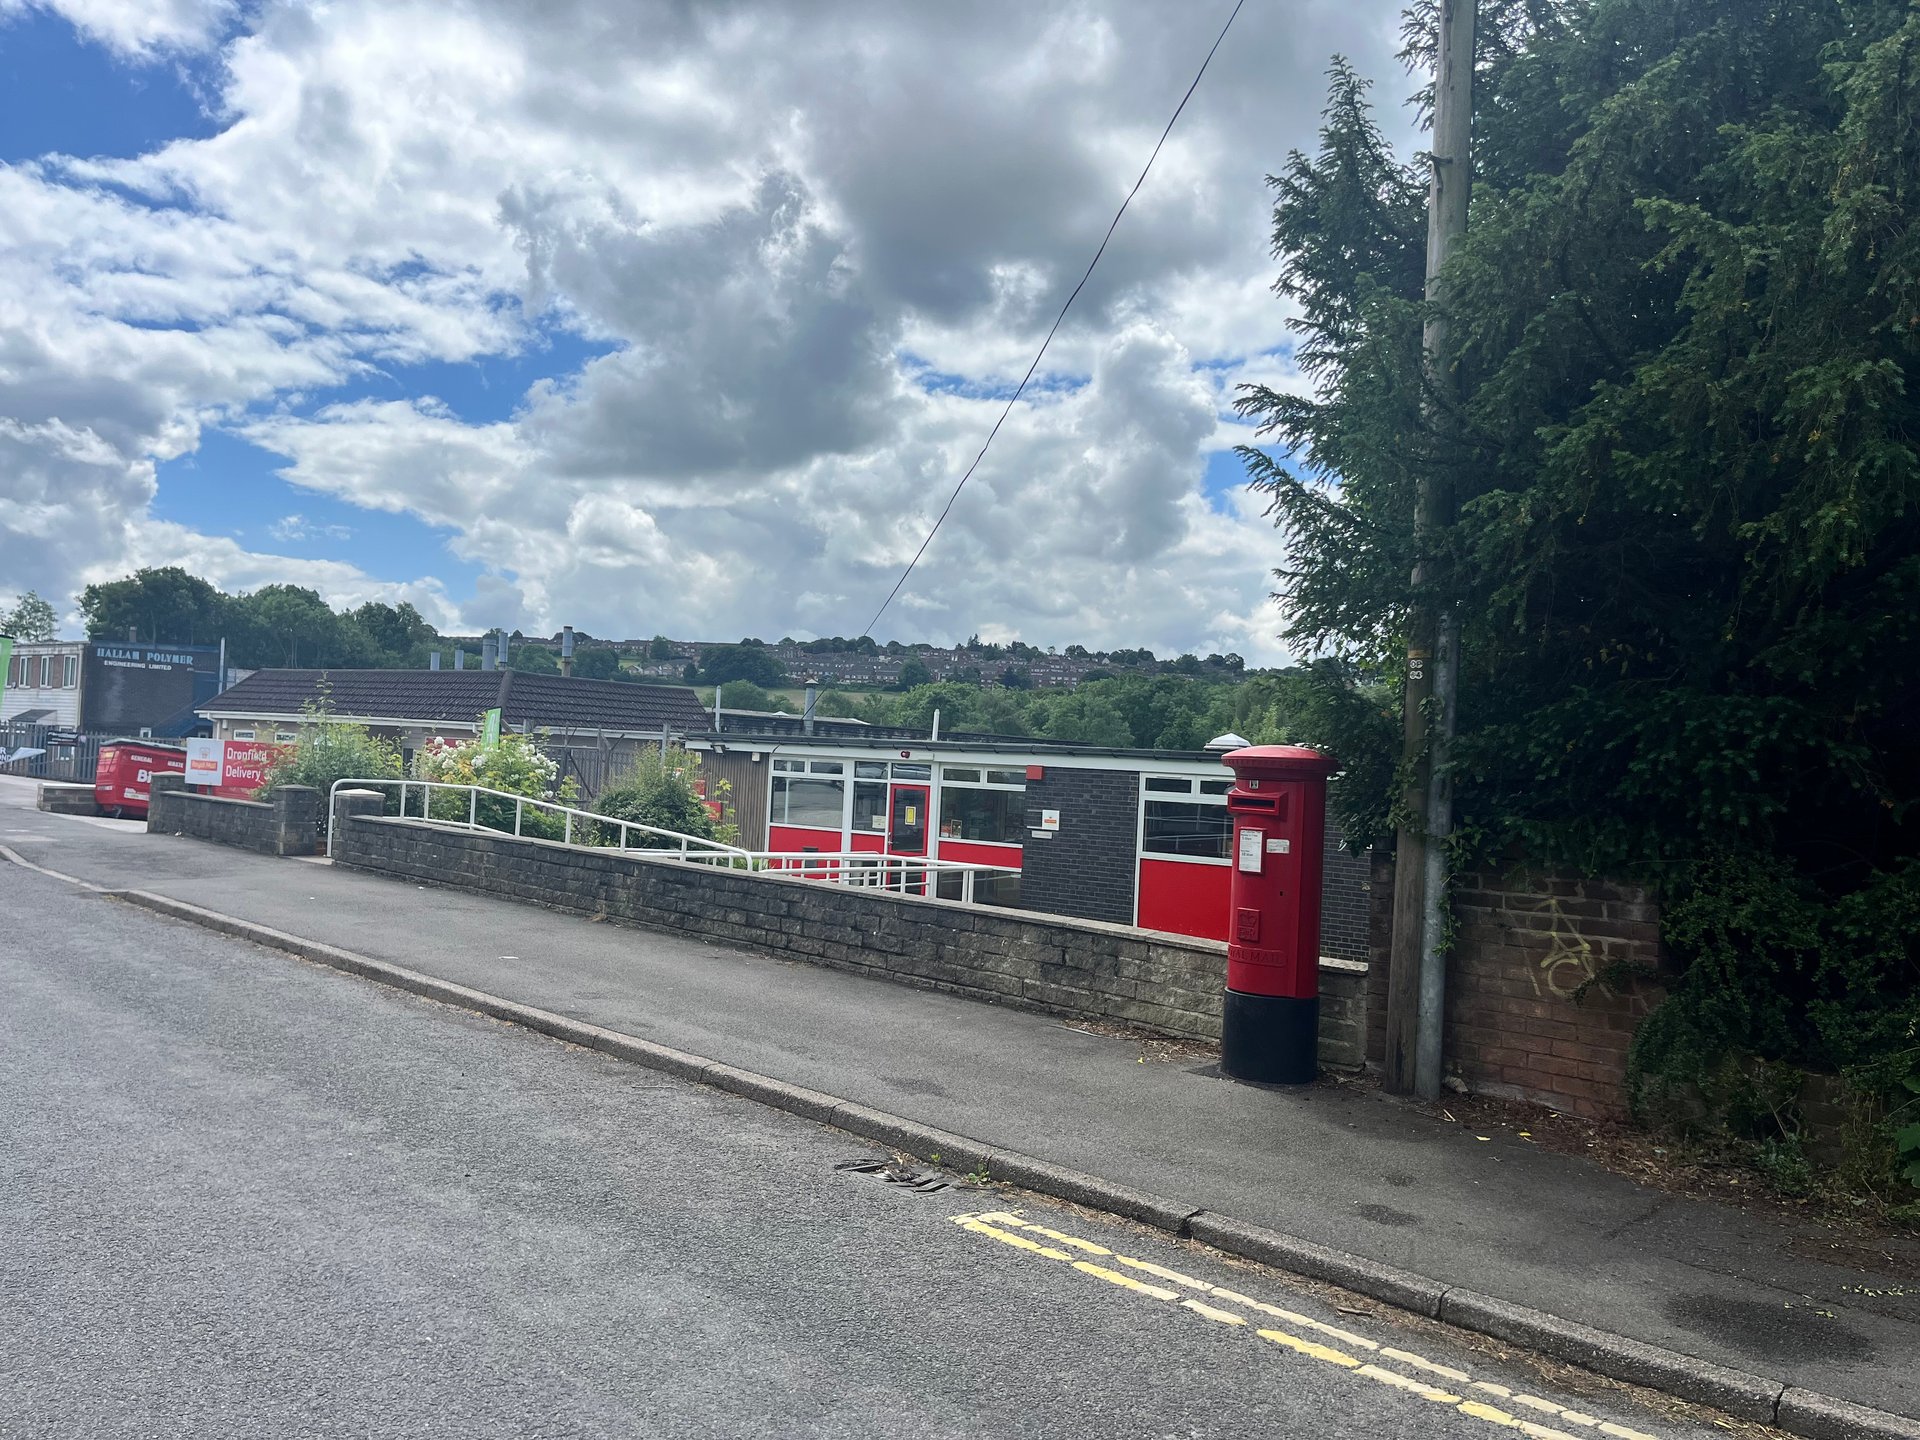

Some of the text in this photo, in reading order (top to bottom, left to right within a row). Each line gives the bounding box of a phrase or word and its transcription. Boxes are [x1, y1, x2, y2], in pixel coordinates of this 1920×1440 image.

[97, 648, 193, 665] HALLAM POLYMER
[104, 660, 172, 671] ENGINEERING LIMITED
[225, 765, 261, 782] Delivery
